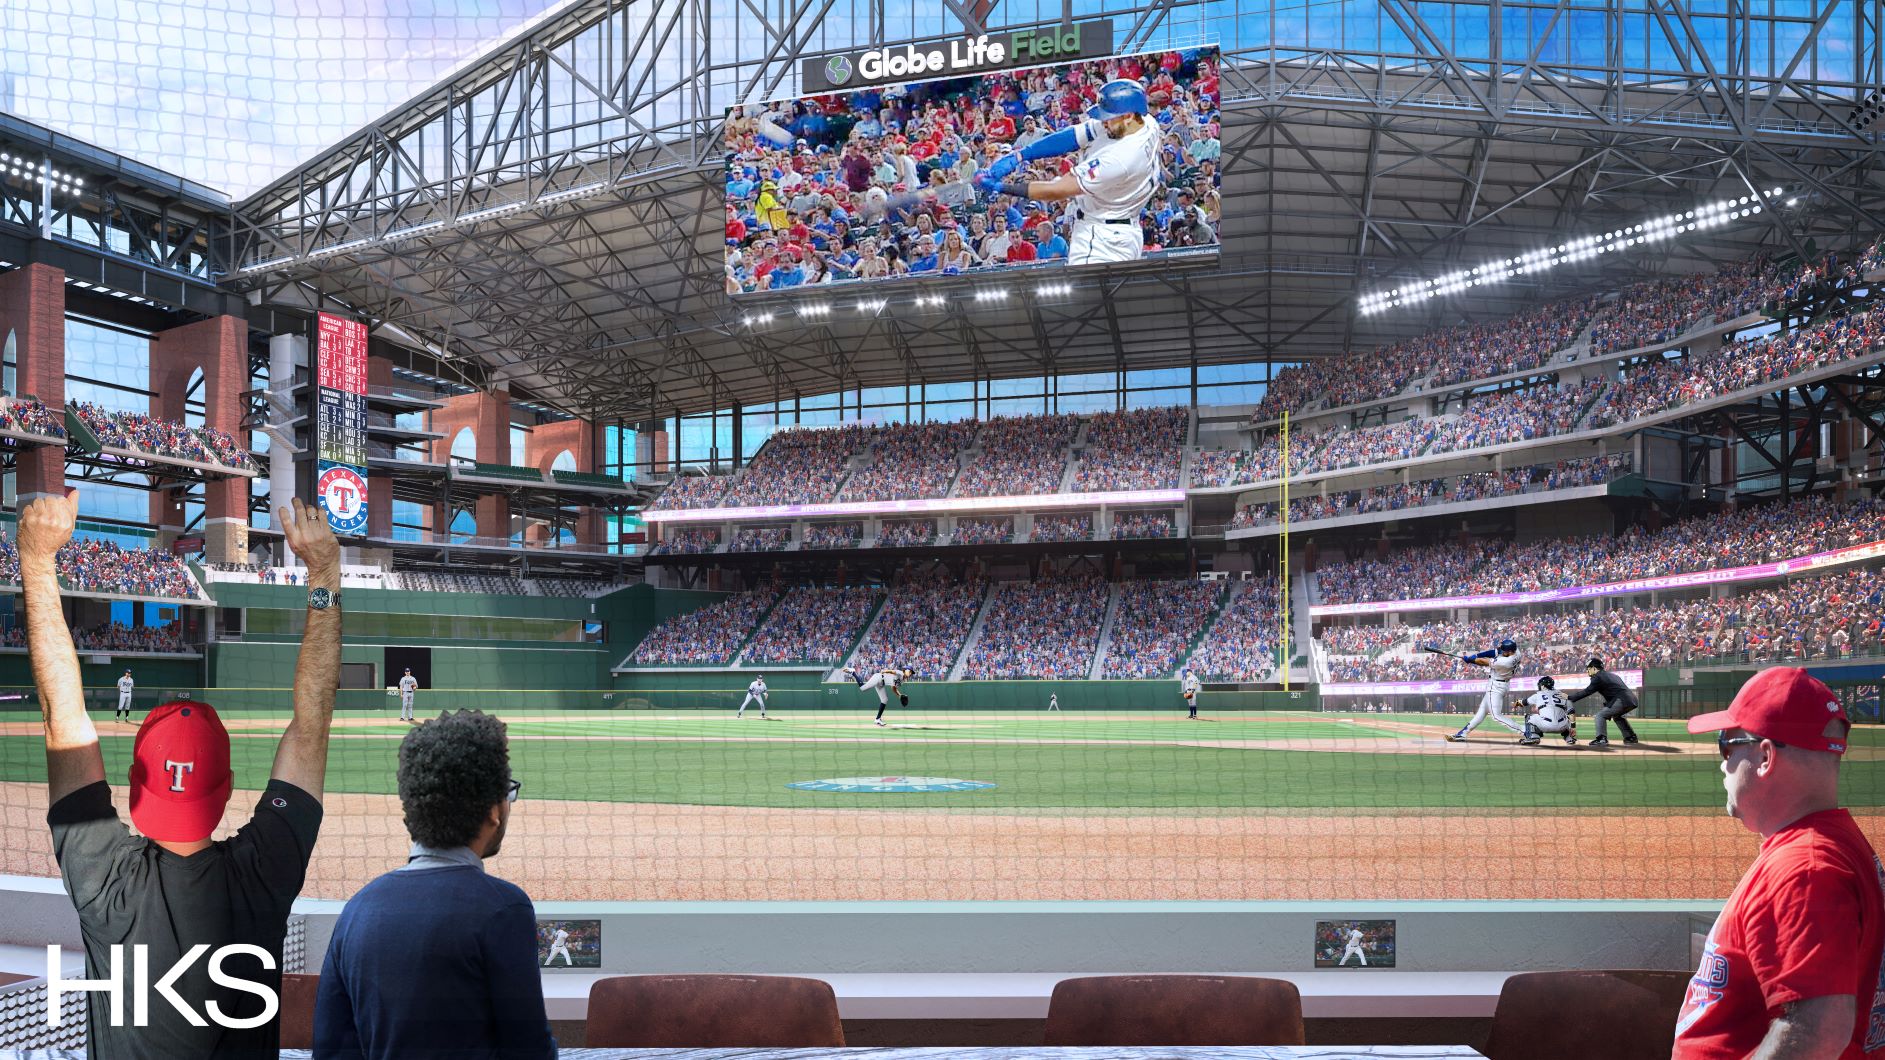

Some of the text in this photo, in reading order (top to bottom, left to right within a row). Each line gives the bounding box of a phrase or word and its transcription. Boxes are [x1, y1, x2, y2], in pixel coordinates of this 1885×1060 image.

[858, 23, 1081, 80] Globe Life Field
[320, 316, 342, 326] AMERICAN
[323, 323, 339, 333] LEAGUE
[345, 320, 355, 331] TOR
[320, 389, 341, 398] NATIONAL
[323, 396, 339, 405] LEAGUE
[324, 471, 362, 489] TEXAS
[333, 486, 353, 513] T
[319, 500, 367, 528] RANGERS
[165, 759, 194, 792] T
